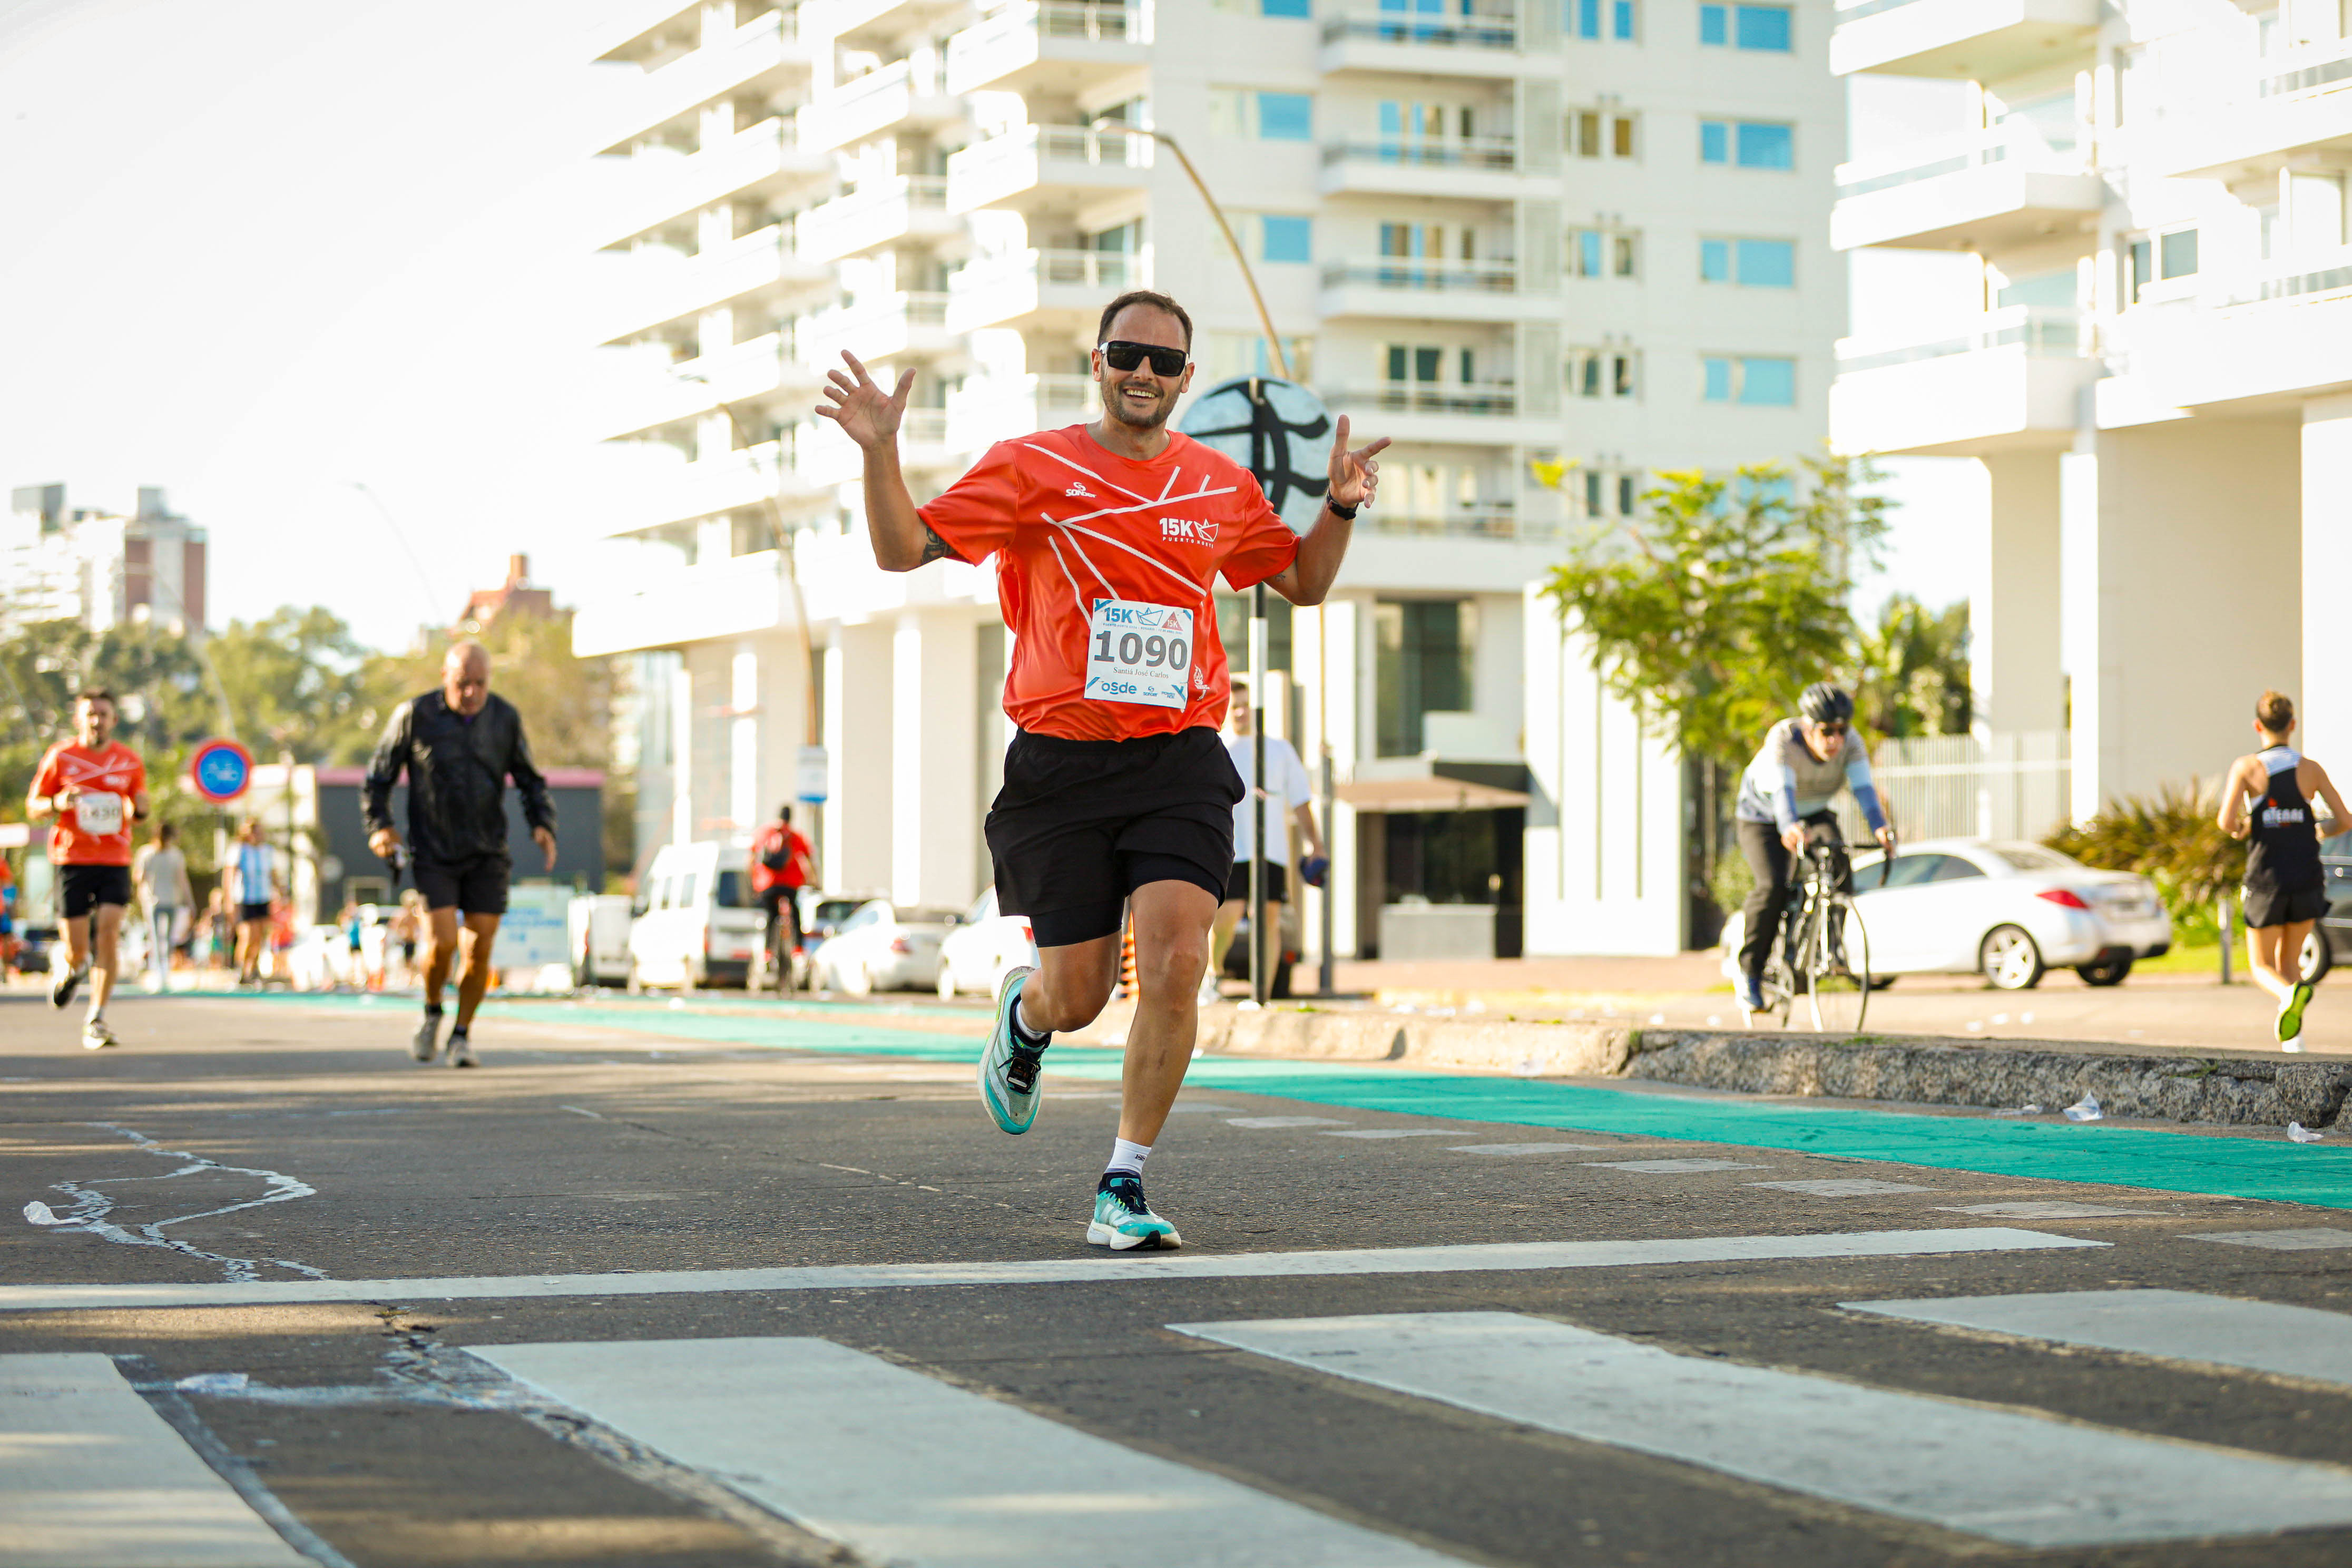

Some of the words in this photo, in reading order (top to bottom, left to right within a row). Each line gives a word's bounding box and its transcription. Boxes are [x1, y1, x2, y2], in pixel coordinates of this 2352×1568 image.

[1159, 518, 1194, 537] 15K
[1104, 607, 1133, 623] 15K
[1167, 619, 1178, 628] 15K
[1094, 630, 1188, 670] 1090
[1113, 667, 1133, 675] Santiá
